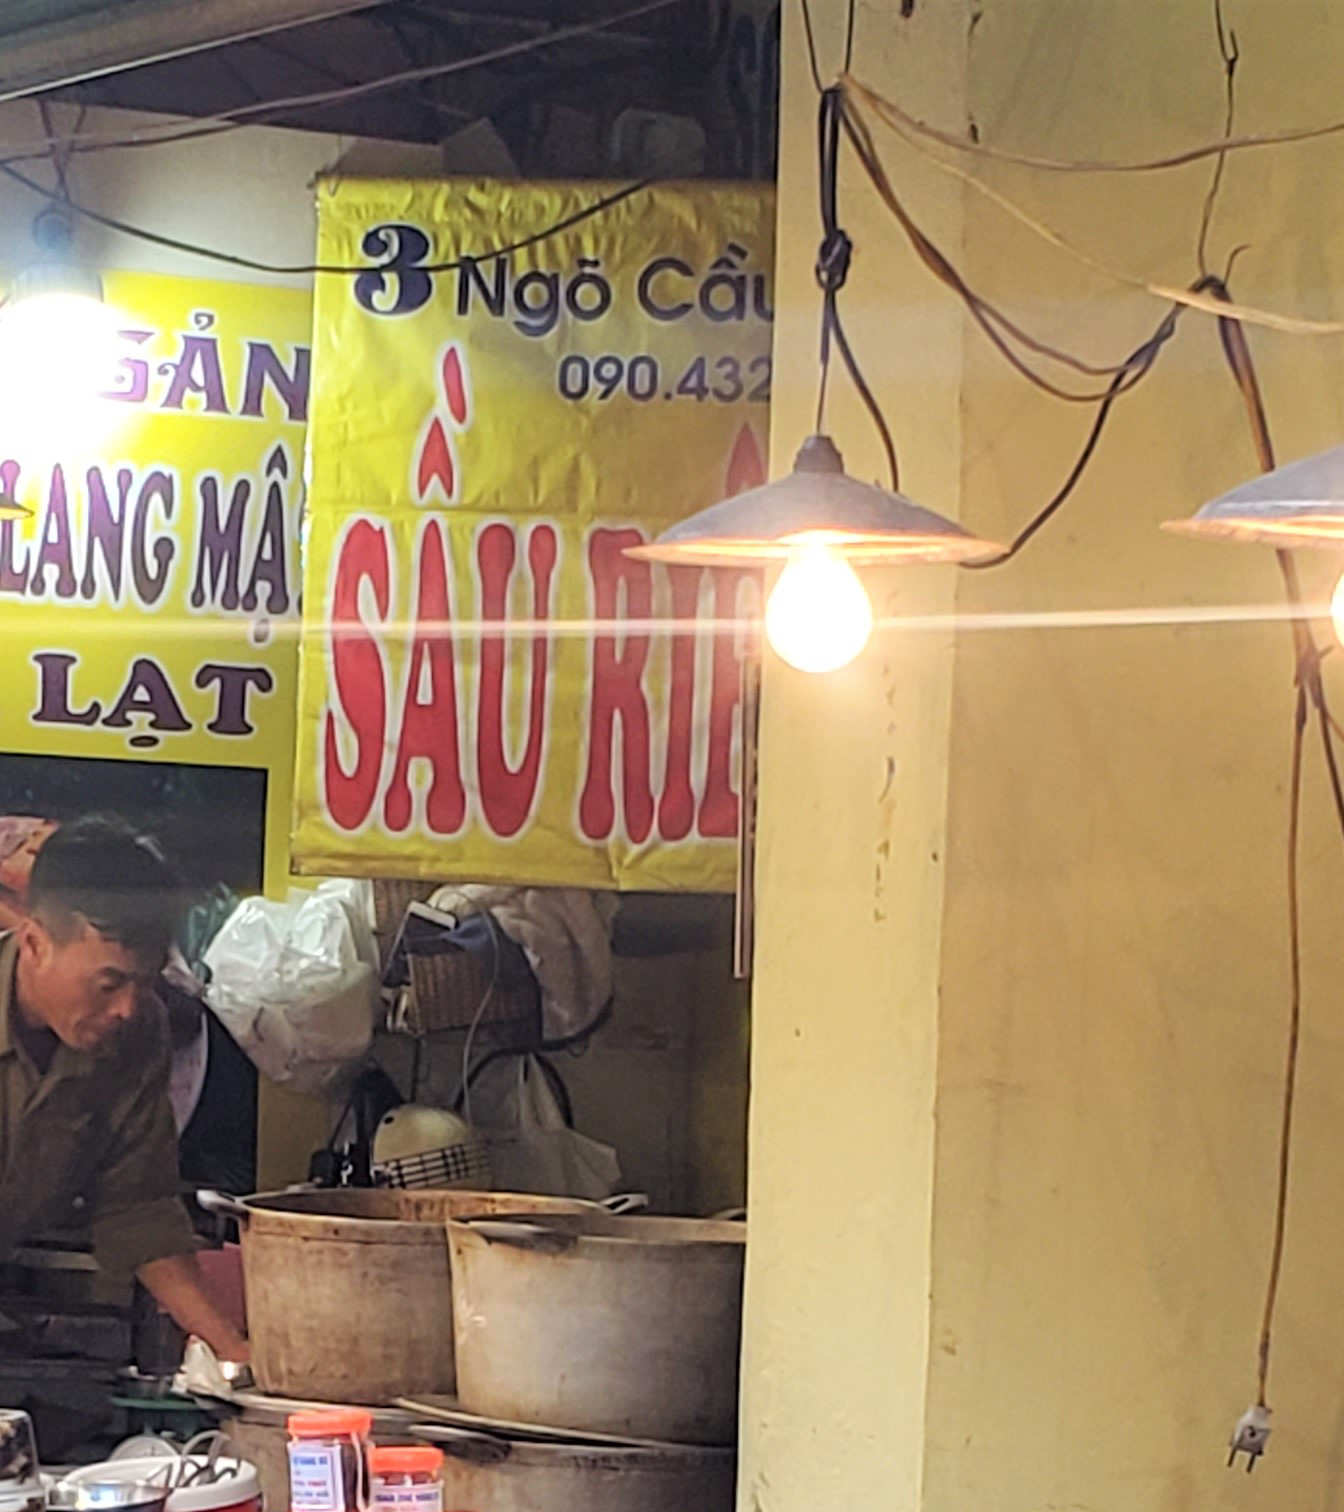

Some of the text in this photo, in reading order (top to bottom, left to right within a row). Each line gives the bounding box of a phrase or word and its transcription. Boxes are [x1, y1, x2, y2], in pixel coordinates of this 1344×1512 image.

[355, 224, 433, 314] 3
[457, 256, 612, 337] Ngõ
[558, 354, 772, 402] 090.432
[191, 444, 304, 644] MẬ
[31, 652, 274, 748] LẠT
